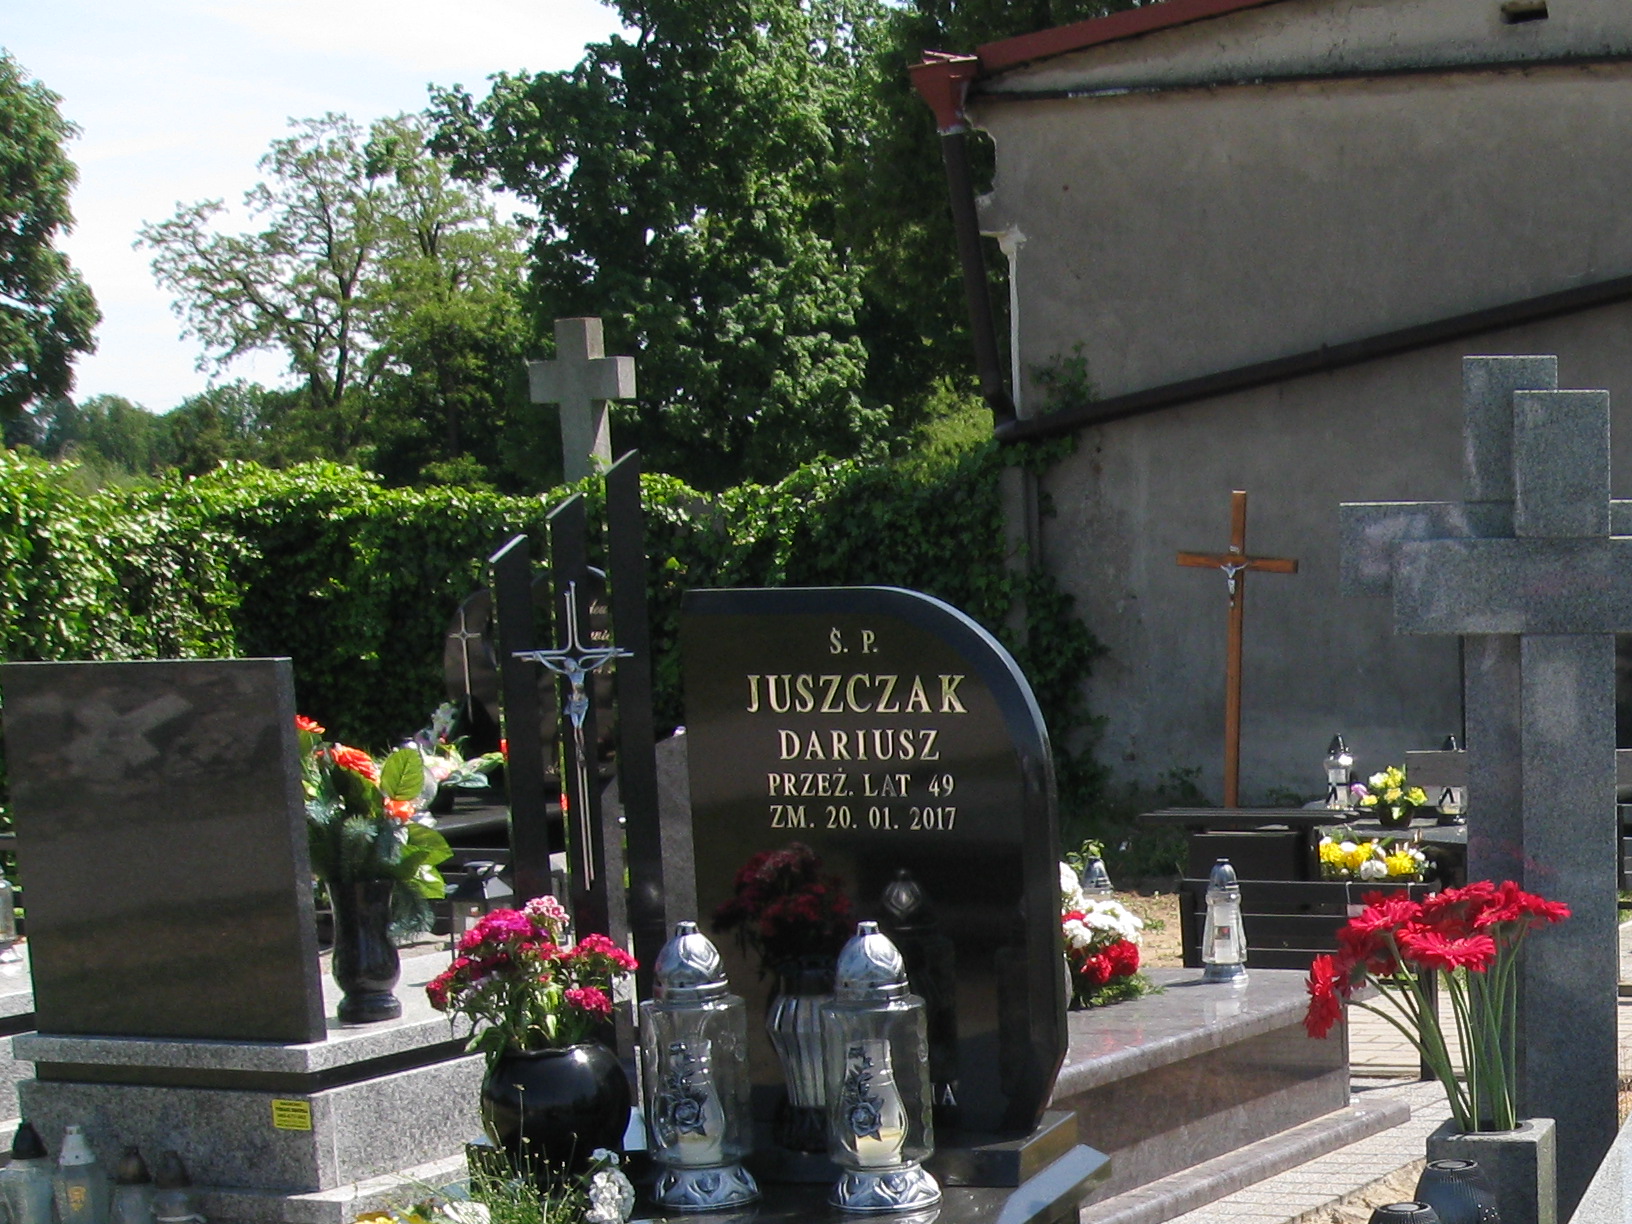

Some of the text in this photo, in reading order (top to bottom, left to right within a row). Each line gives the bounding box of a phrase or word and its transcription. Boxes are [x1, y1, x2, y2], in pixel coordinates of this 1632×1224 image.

[862, 630, 878, 654] P.
[747, 674, 968, 714] JUSZCZAK
[778, 729, 940, 761] DARIUSZ
[768, 767, 955, 798] PRZEŻ. LAT 49
[770, 805, 957, 830] ZM. 20. 01. 2017
